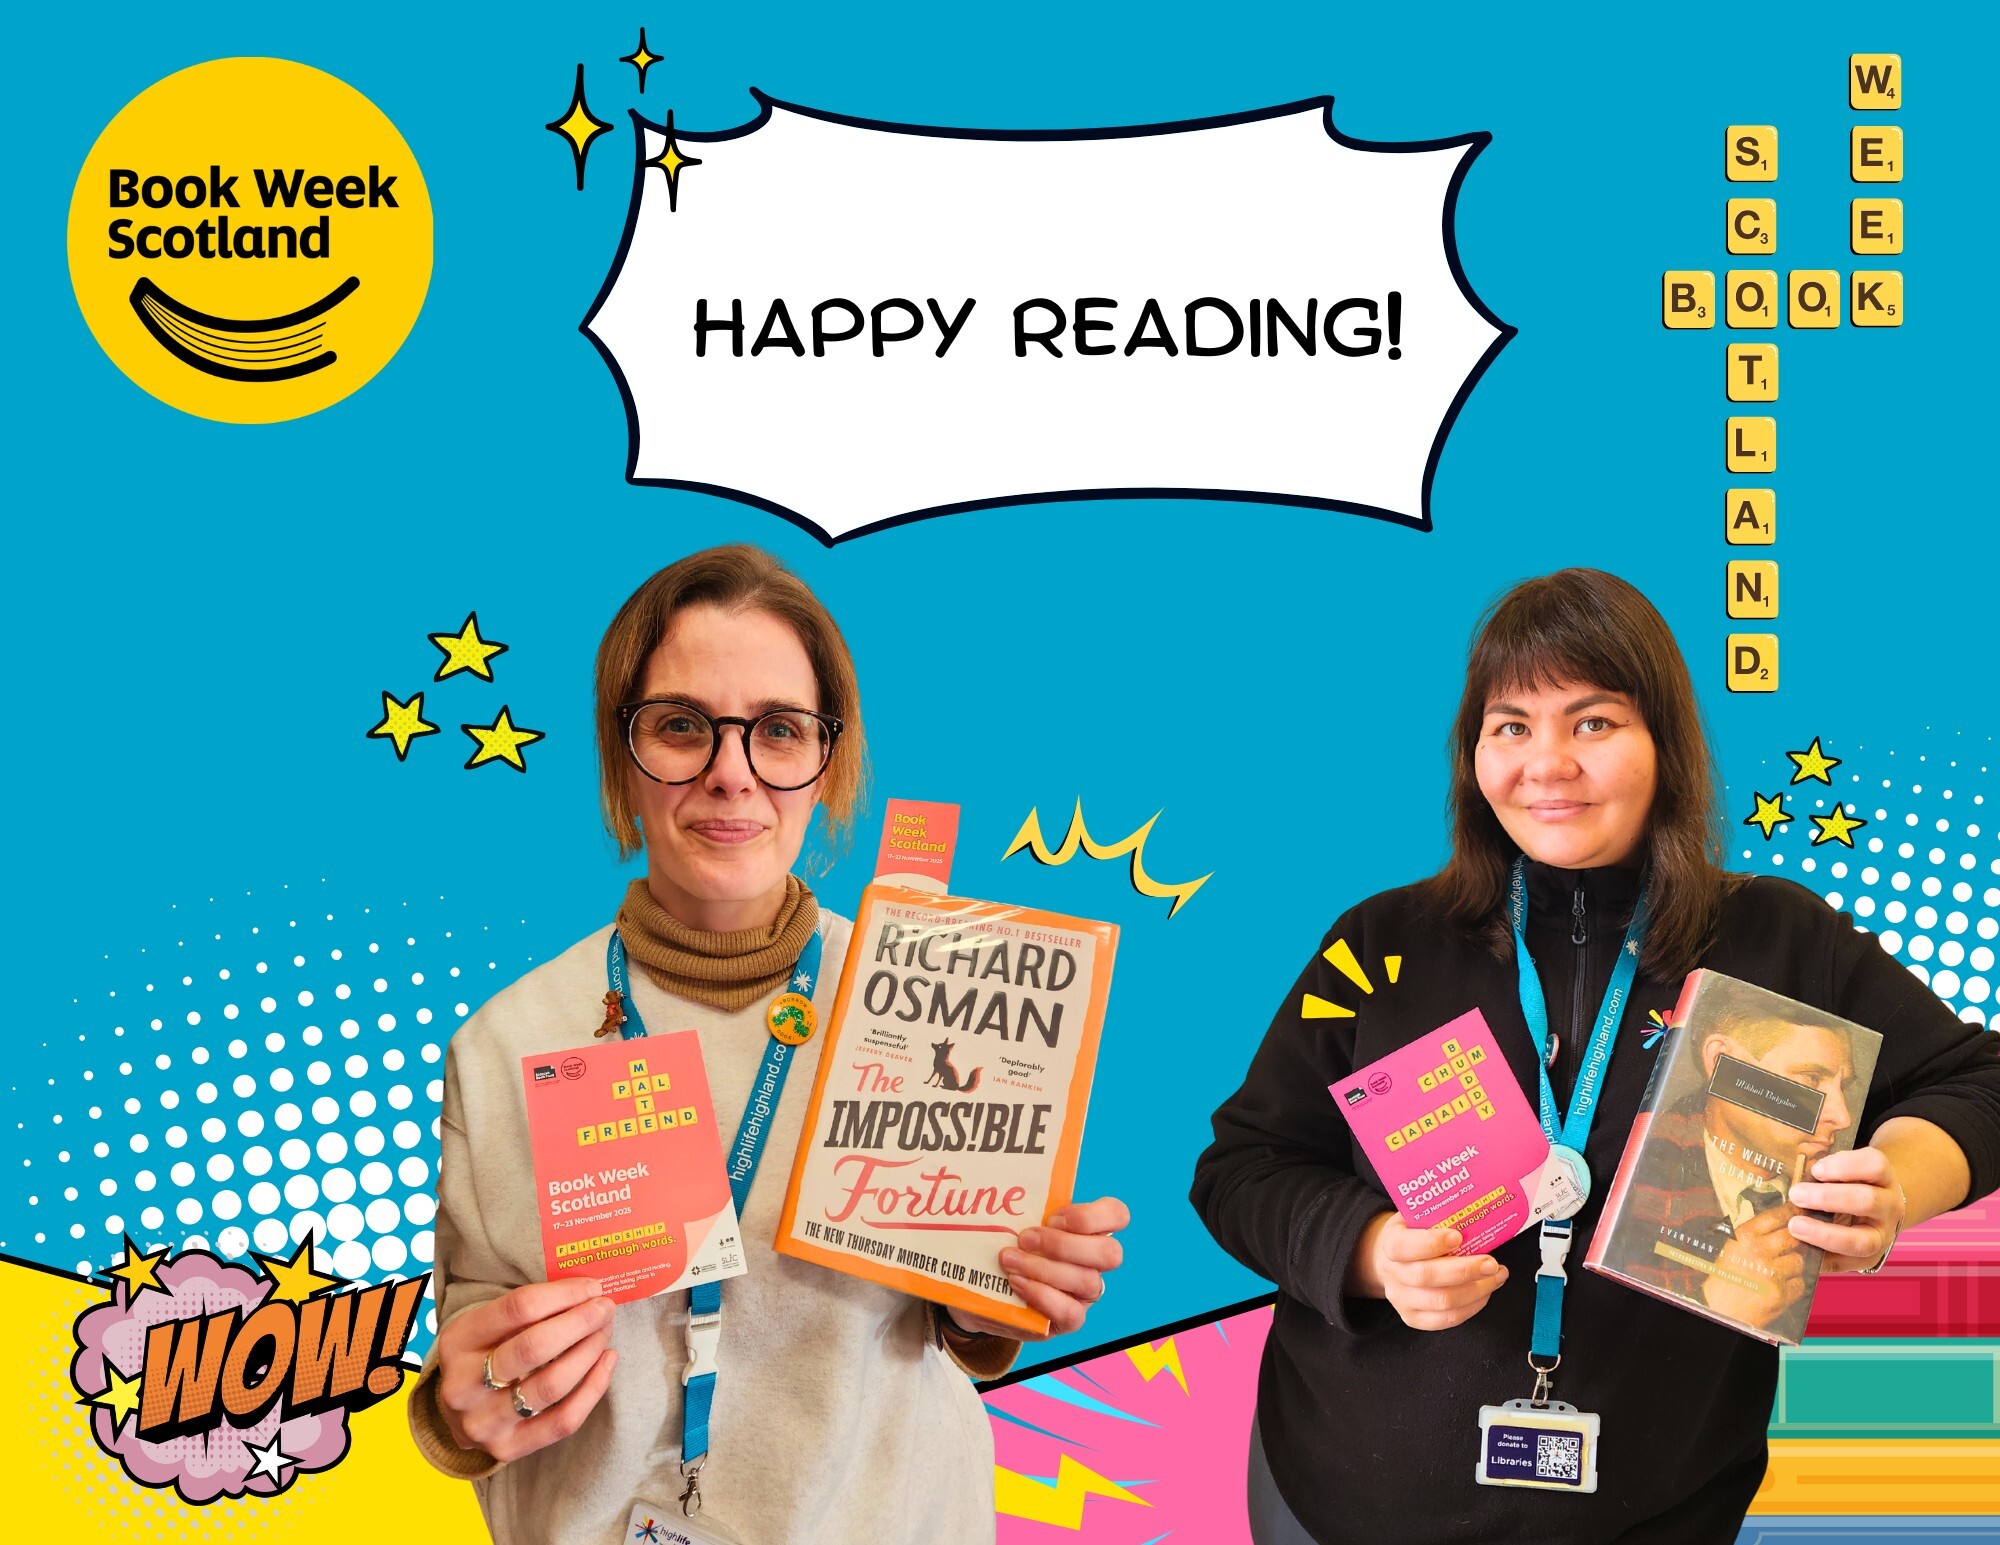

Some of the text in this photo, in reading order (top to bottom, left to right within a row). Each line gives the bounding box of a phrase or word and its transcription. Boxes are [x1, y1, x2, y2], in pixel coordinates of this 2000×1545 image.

[892, 825, 928, 838] Week
[894, 813, 927, 825] Book
[889, 838, 947, 853] Scotland
[885, 907, 902, 917] THE
[997, 926, 1020, 937] NO.1
[1024, 931, 1082, 948] BESTSELLER
[863, 969, 1064, 1049] OSMAN
[1574, 988, 1623, 1116] highlifehighland.com
[852, 1062, 904, 1094] The
[582, 1110, 694, 1142] FREEND
[823, 1099, 1053, 1155] IMPOSS!BLE
[1397, 1145, 1480, 1197] Book Week
[1711, 1135, 1784, 1175] THE WHITE
[548, 1161, 650, 1197] Book Week
[824, 1154, 1027, 1223] Fortune
[1405, 1165, 1471, 1211] Scotland
[1719, 1160, 1763, 1188] GUARD
[550, 1183, 632, 1216] Scotland
[1430, 1193, 1460, 1213] November
[574, 1211, 613, 1226] November
[613, 1206, 632, 1217] 2025
[1456, 1208, 1490, 1231] through
[557, 1223, 665, 1255] FRIENDSHIP
[557, 1235, 677, 1270] woven through words.
[804, 1220, 823, 1239] THE
[823, 1225, 845, 1246] NEW
[846, 1232, 896, 1261] THURSDAY
[896, 1247, 939, 1274] MURDER
[940, 1260, 966, 1282] CLUB
[1660, 1225, 1725, 1258] EVERYMAN'S
[1497, 1441, 1520, 1449] donate
[1502, 1433, 1524, 1441] Please
[1490, 1455, 1533, 1467] Libraries
[660, 1526, 691, 1545] highlife
